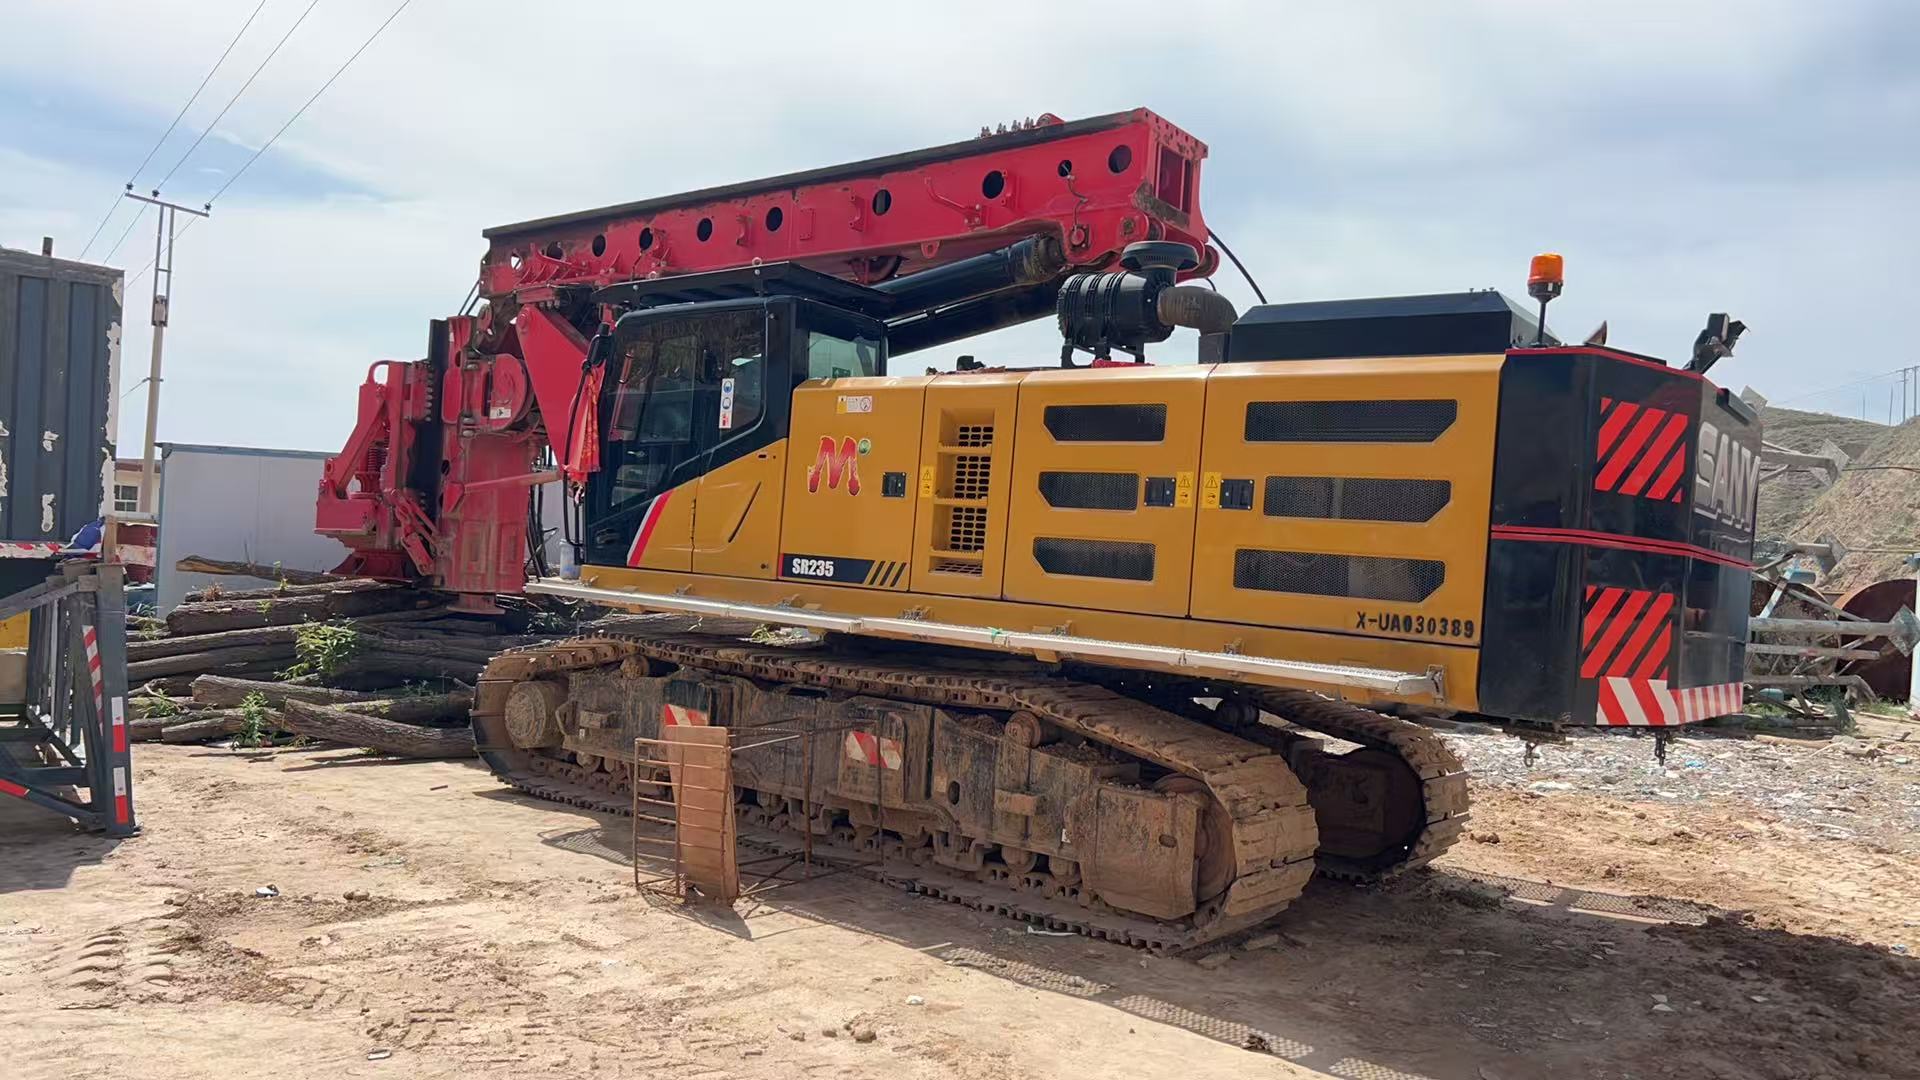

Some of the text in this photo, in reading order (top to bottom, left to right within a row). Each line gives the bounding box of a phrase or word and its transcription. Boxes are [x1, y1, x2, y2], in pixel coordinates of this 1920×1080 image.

[1694, 421, 1761, 532] SANY
[792, 558, 834, 577] SR235
[1356, 611, 1474, 638] X-UA030389
